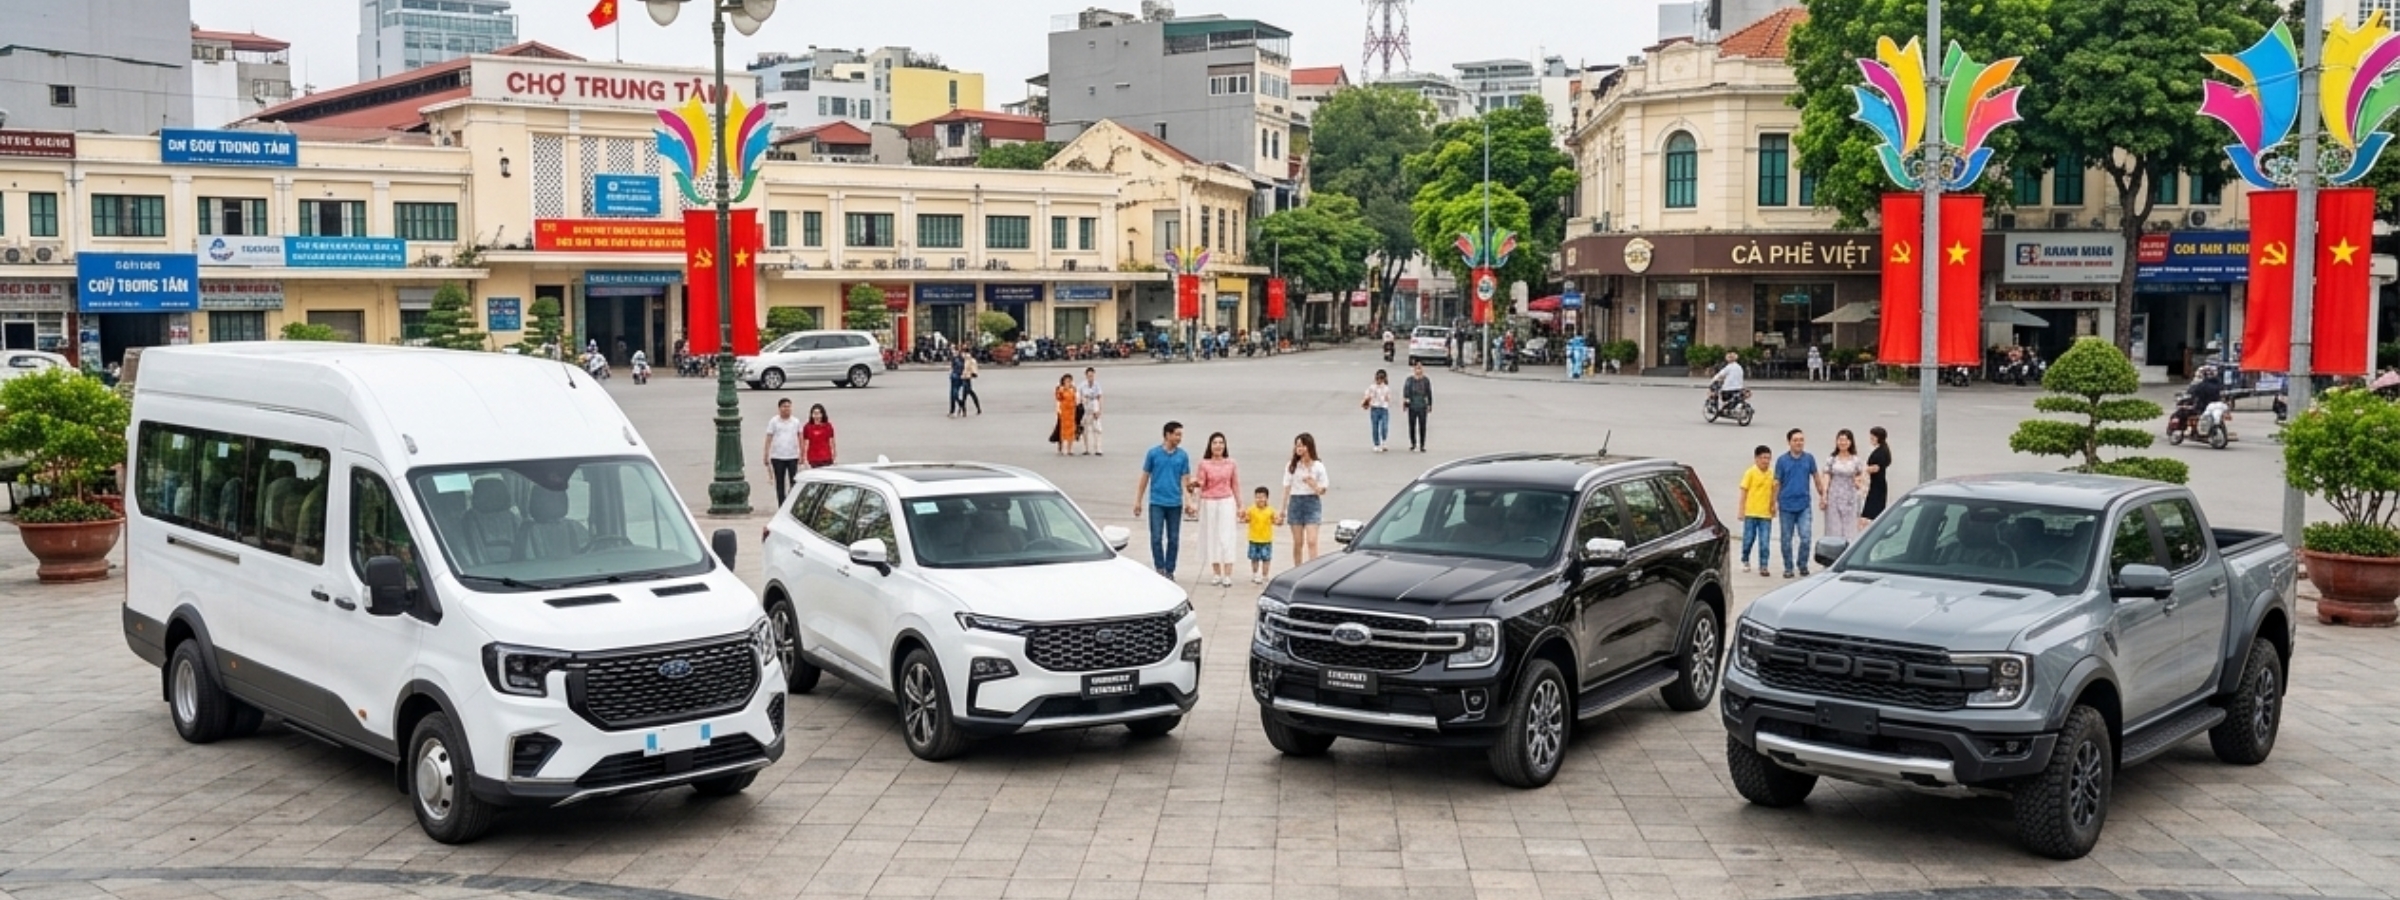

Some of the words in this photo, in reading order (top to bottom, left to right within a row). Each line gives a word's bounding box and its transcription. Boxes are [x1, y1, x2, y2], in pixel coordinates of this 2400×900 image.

[507, 72, 566, 102] CHỢ
[575, 76, 665, 101] TRUNG
[1731, 240, 1764, 264] CÀ
